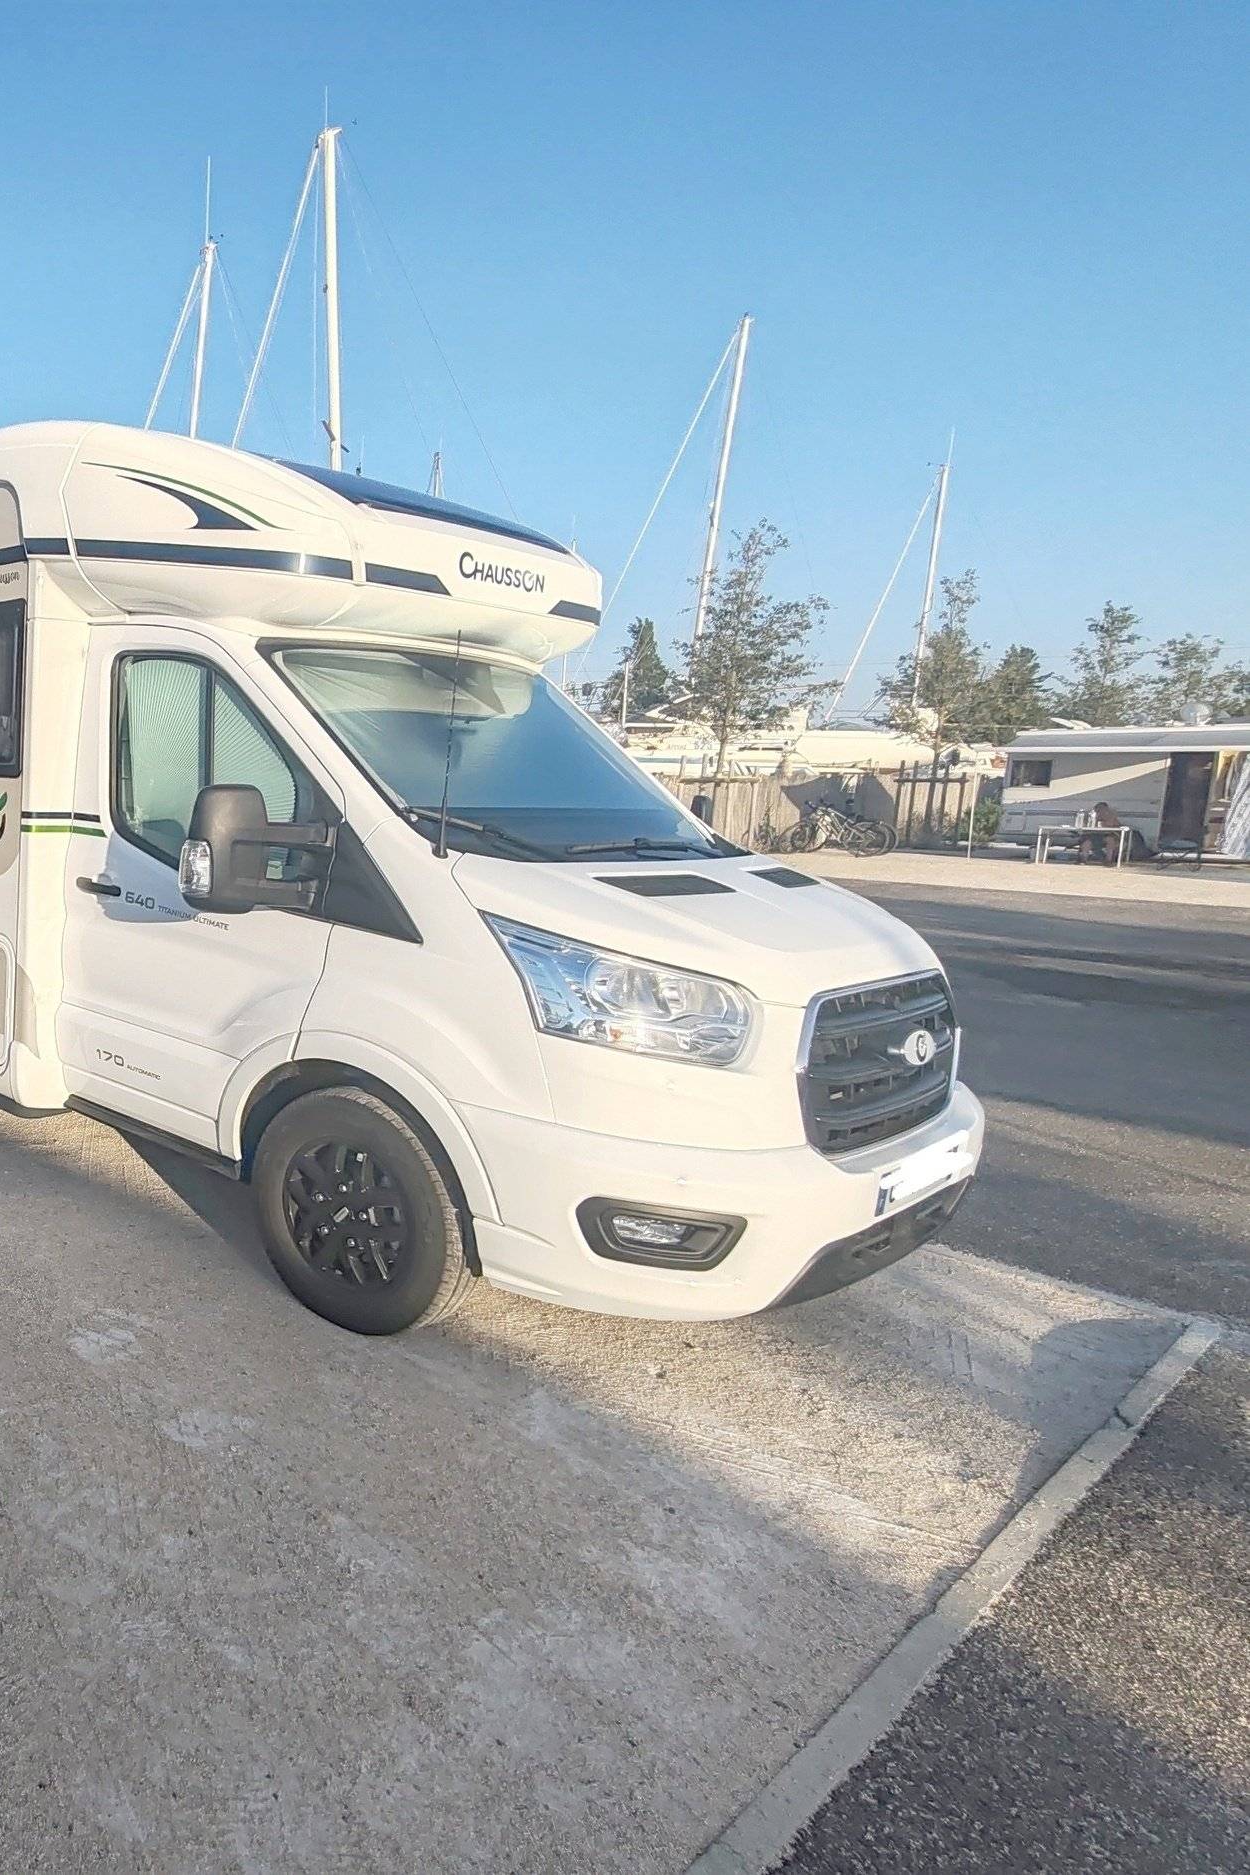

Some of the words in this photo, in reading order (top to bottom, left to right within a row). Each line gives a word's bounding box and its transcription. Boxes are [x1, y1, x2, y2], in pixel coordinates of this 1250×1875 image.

[459, 551, 545, 593] CHAUSSON
[124, 891, 156, 909] 640
[96, 1048, 125, 1067] 170
